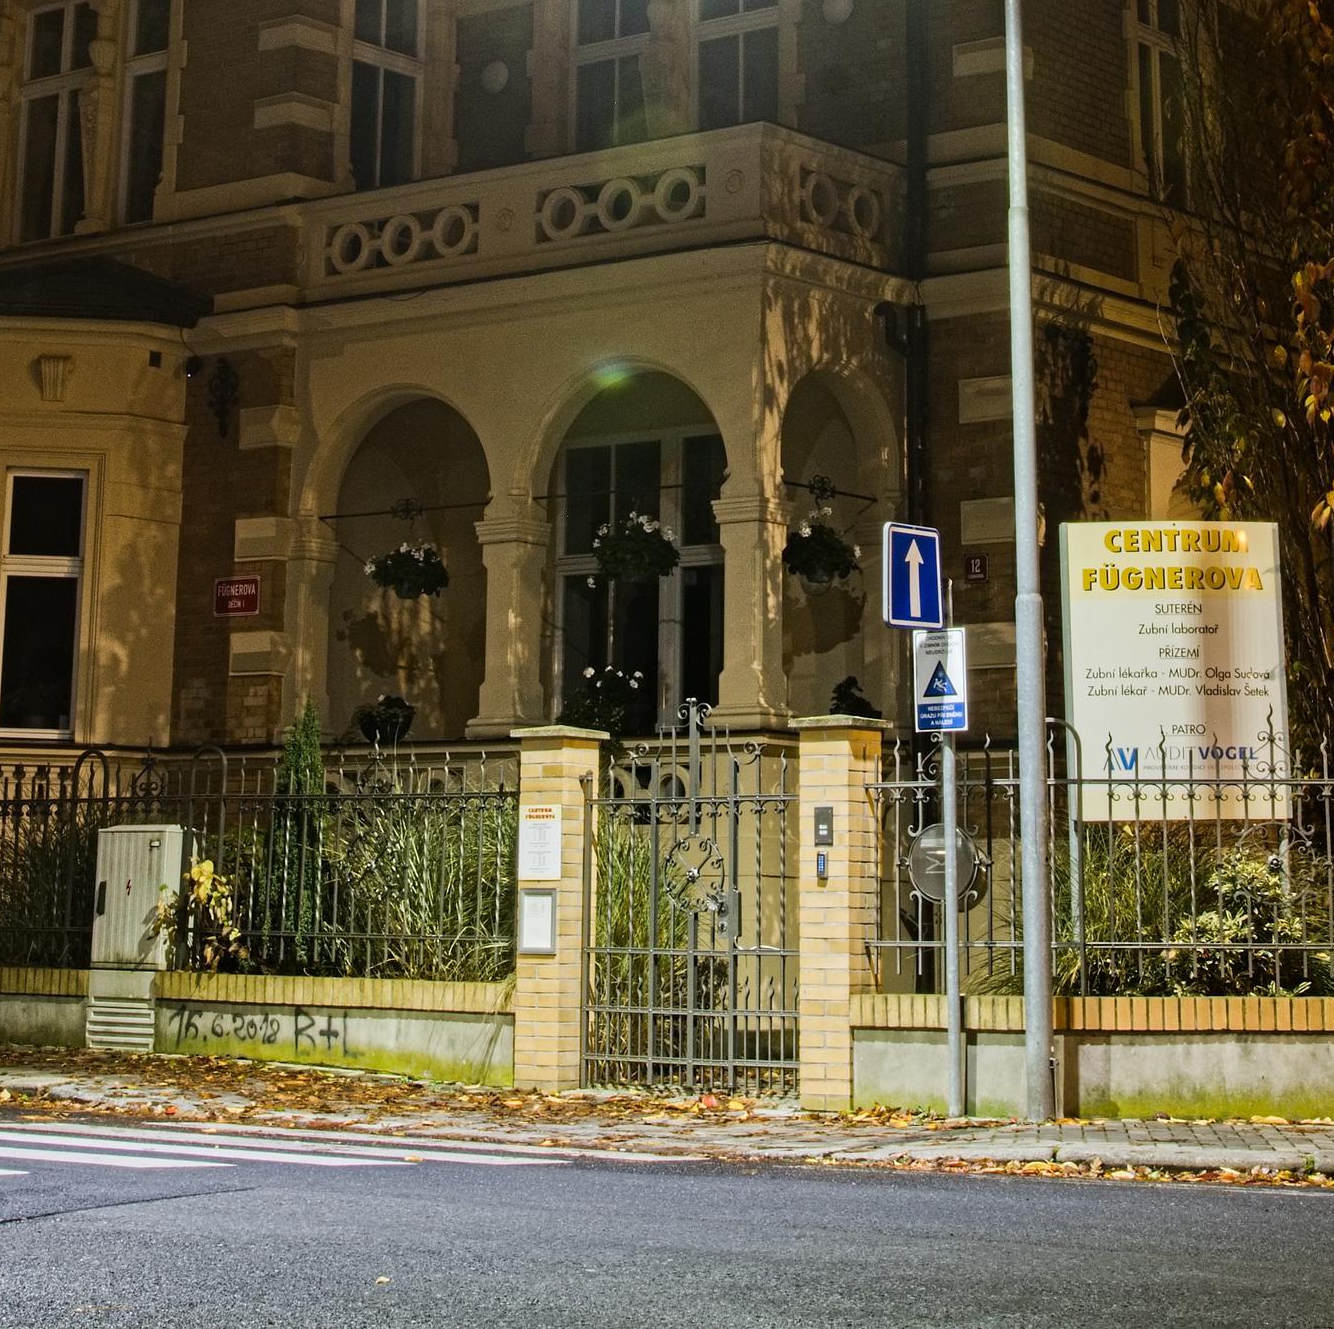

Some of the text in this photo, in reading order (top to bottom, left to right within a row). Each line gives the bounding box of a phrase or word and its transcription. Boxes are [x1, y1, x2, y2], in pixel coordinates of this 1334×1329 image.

[1104, 529, 1248, 553] CENTRUM
[971, 559, 981, 573] 12
[1082, 562, 1263, 591] FÜGNEROVA
[218, 583, 256, 597] FÜGNEROVA
[1154, 601, 1202, 615] SUTERÉN
[1138, 622, 1219, 635] Zubní laboratoř
[1159, 645, 1200, 658] PŘÍZEMÍ
[1085, 667, 1116, 679] Zubní
[1119, 667, 1158, 679] lékařka
[1169, 667, 1202, 679] MUDr.
[1205, 667, 1231, 681] Olga
[1088, 684, 1118, 697] Zubní
[1121, 684, 1148, 696] lékař
[1158, 685, 1191, 696] MUDr.
[1195, 684, 1241, 696] Vladislav
[1243, 682, 1270, 697] Šetek
[1172, 724, 1206, 735] PATRO
